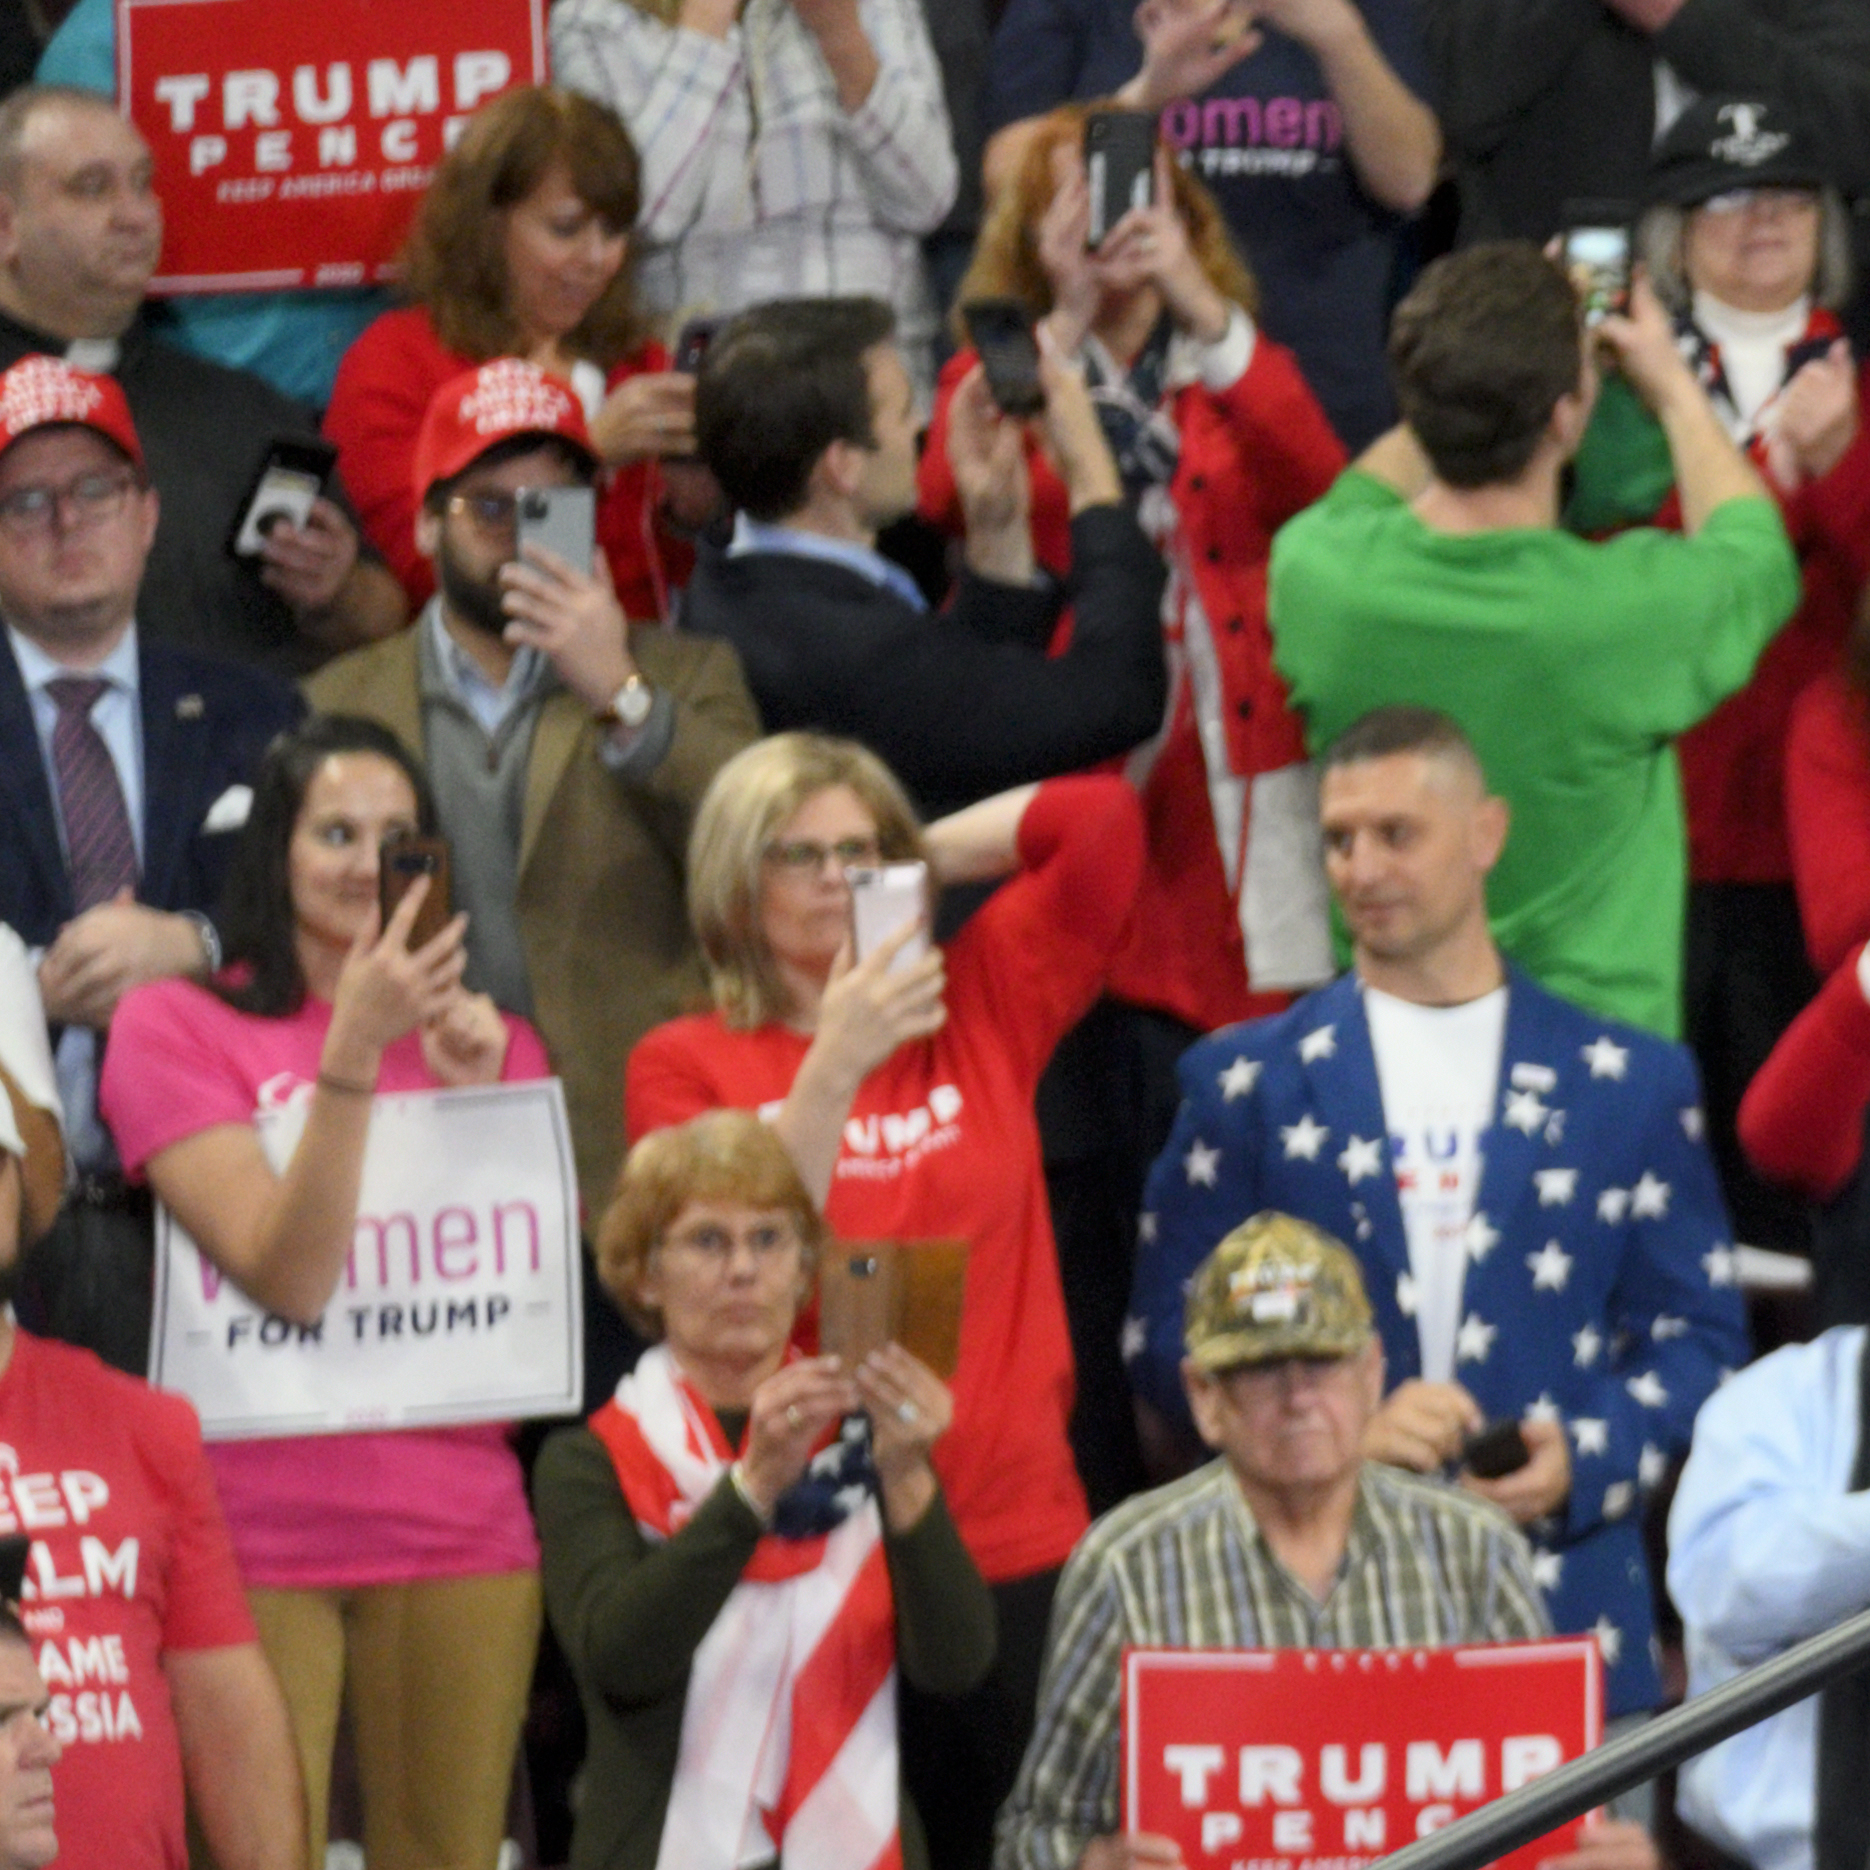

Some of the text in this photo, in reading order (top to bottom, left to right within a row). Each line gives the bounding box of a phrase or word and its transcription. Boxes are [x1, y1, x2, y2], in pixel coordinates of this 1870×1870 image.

[154, 49, 512, 134] TRUMP
[1160, 96, 1343, 152] omen
[227, 1293, 512, 1354] FOR TRUMP
[40, 1691, 143, 1745] SSIA
[1163, 1734, 1563, 1808] TRUMP
[1200, 1804, 1460, 1856] PENC
